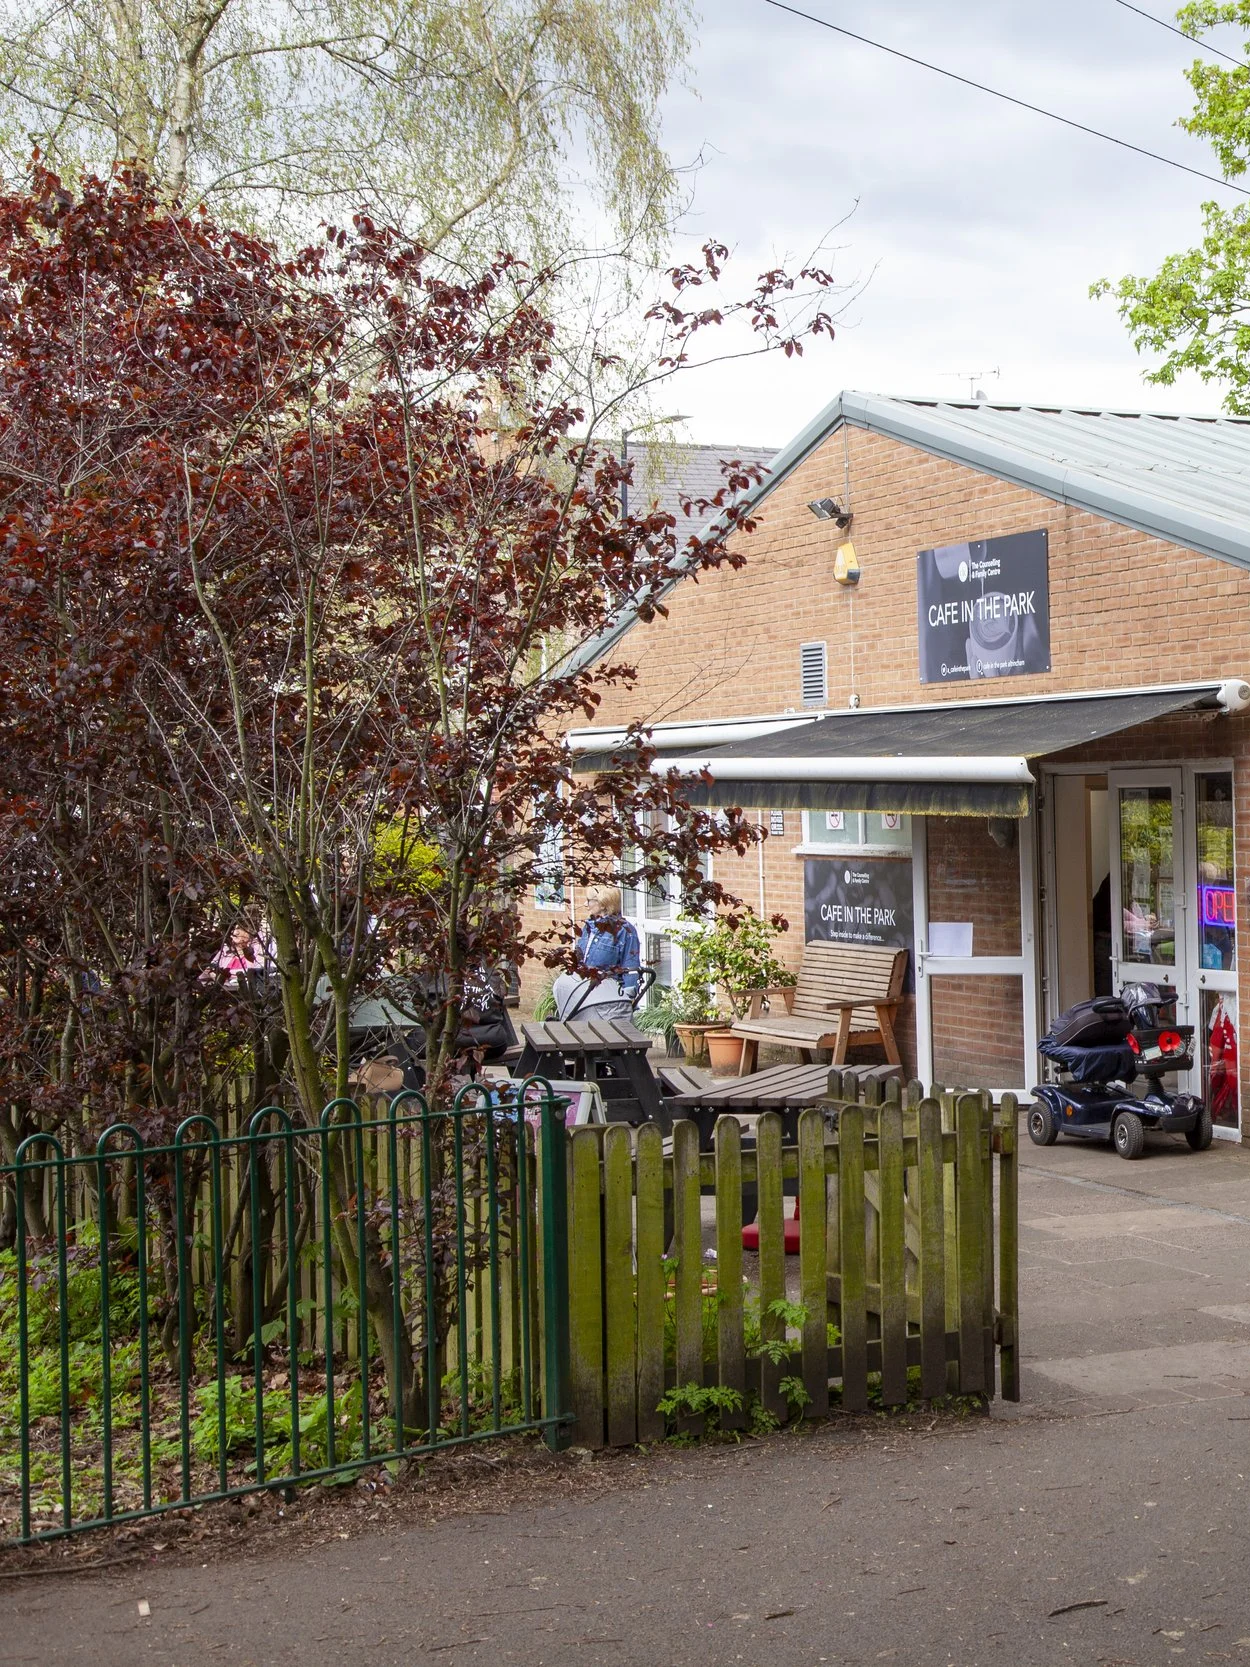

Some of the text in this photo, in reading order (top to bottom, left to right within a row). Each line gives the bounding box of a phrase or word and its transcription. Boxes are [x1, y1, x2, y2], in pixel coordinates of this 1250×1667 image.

[928, 590, 1036, 627] CAFE IN THE PARK
[820, 903, 896, 927] CAFE IN THE PARK
[1206, 890, 1235, 922] OPE
[830, 929, 839, 939] Step
[839, 930, 848, 939] inside
[852, 931, 861, 940] make
